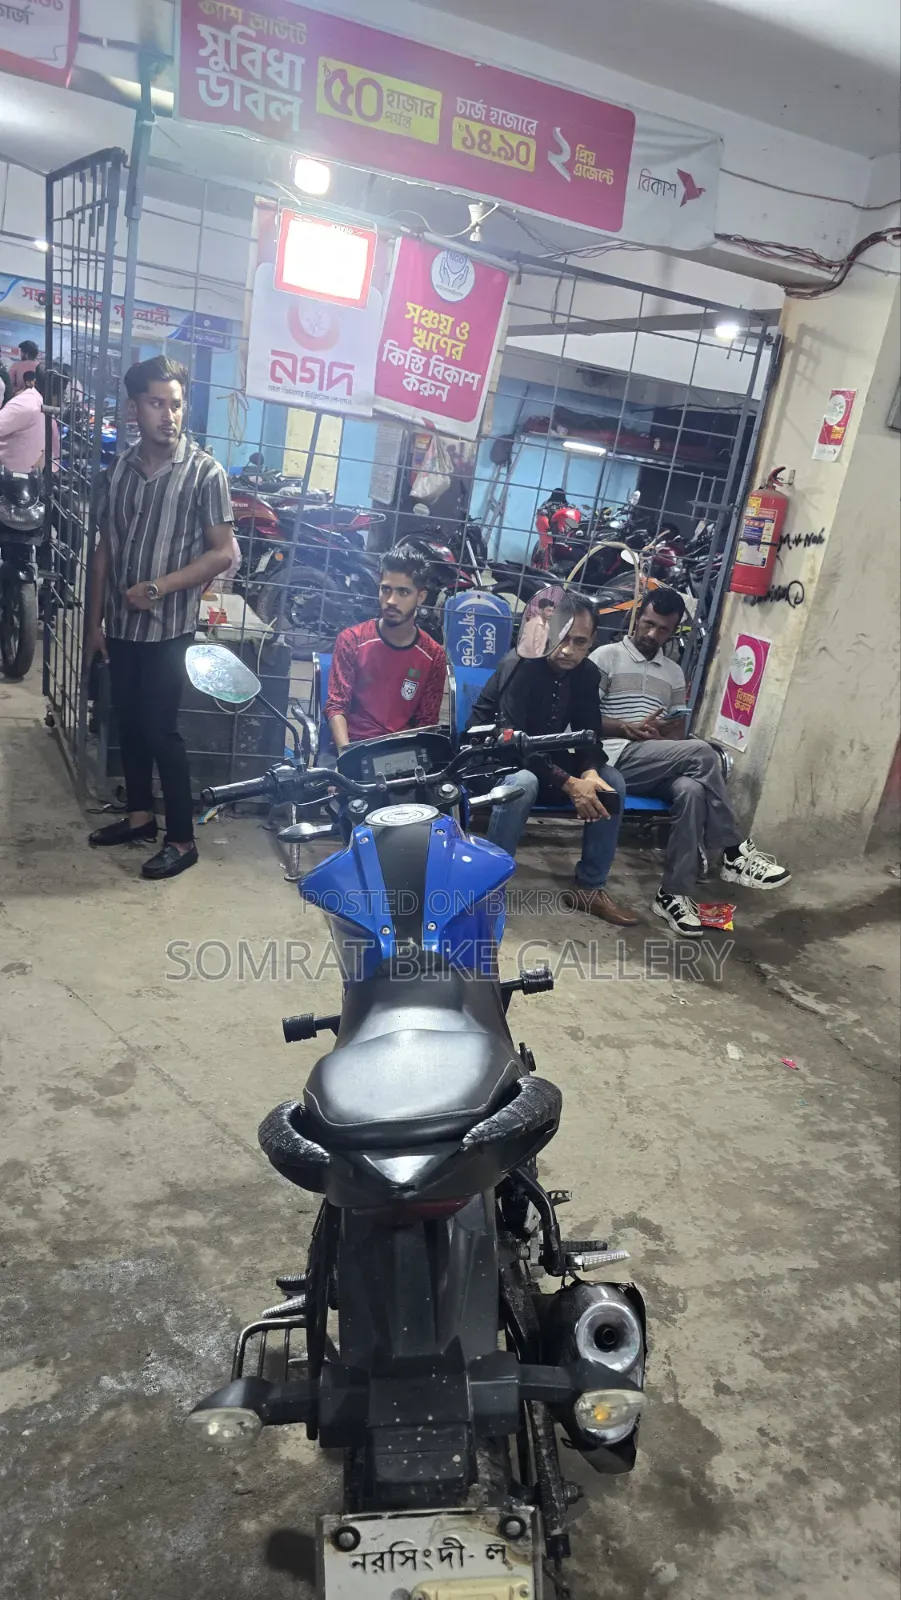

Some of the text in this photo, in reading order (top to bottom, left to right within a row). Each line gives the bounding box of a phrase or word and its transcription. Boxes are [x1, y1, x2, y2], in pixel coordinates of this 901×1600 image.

[197, 24, 306, 92] সুবিধা
[196, 68, 304, 132] ডাবল
[386, 88, 438, 120] হাজার
[456, 96, 538, 136] চার্জ হাজারে
[547, 127, 571, 183] ২
[575, 143, 596, 165] প্রিয়
[637, 168, 677, 199] বিকাশ
[404, 301, 470, 340] সঞ্চয় ও
[412, 326, 466, 361] ঋণের
[269, 349, 355, 397] নগদ
[382, 339, 482, 391] কিস্তি বিকাশ
[402, 372, 450, 402] করুন
